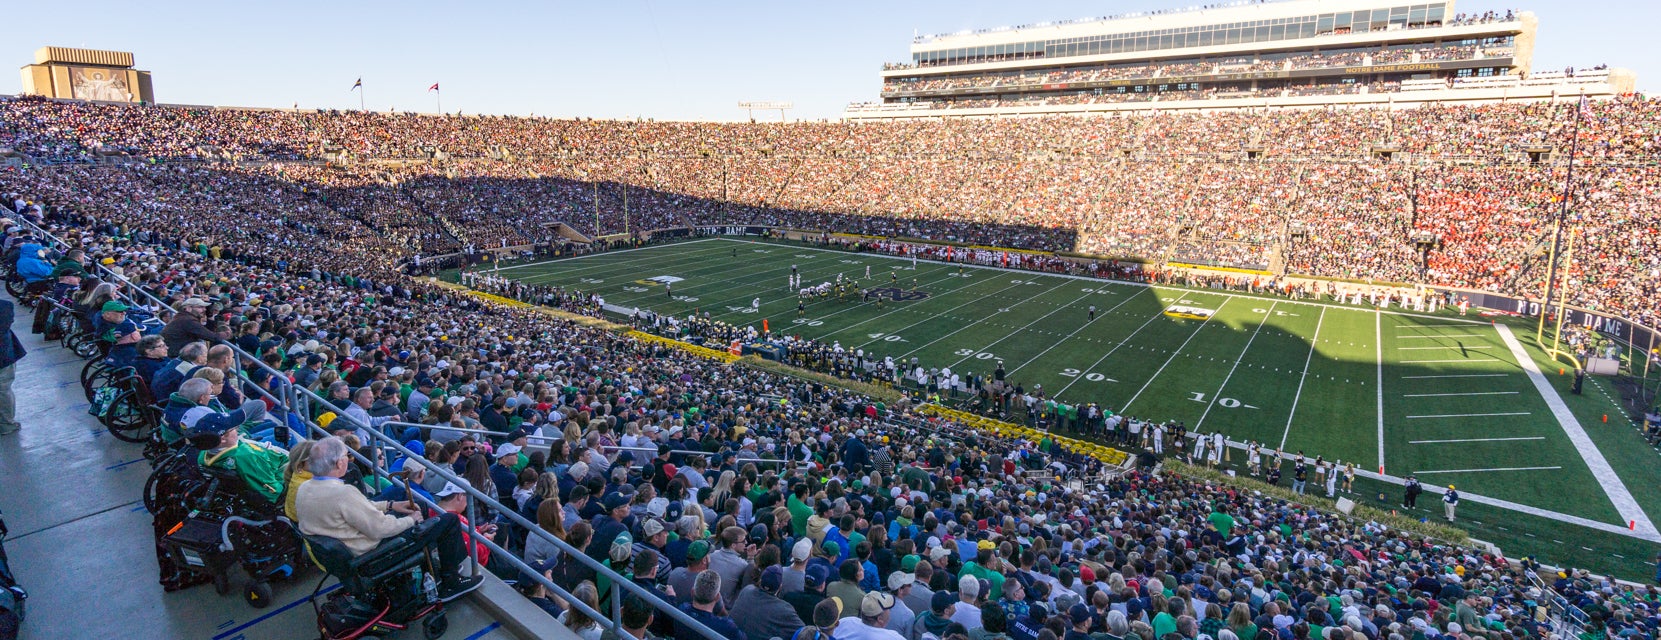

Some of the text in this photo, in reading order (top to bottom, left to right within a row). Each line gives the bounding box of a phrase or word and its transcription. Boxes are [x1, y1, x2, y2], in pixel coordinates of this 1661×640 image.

[1397, 63, 1440, 71] FOOTBALL
[725, 226, 746, 236] DAME
[1252, 308, 1288, 317] 10
[1517, 300, 1622, 337] NORE DAME
[868, 333, 901, 342] 40
[954, 348, 994, 360] 30
[1058, 368, 1105, 382] 20
[1187, 391, 1241, 408] 10
[1028, 629, 1040, 638] DAM
